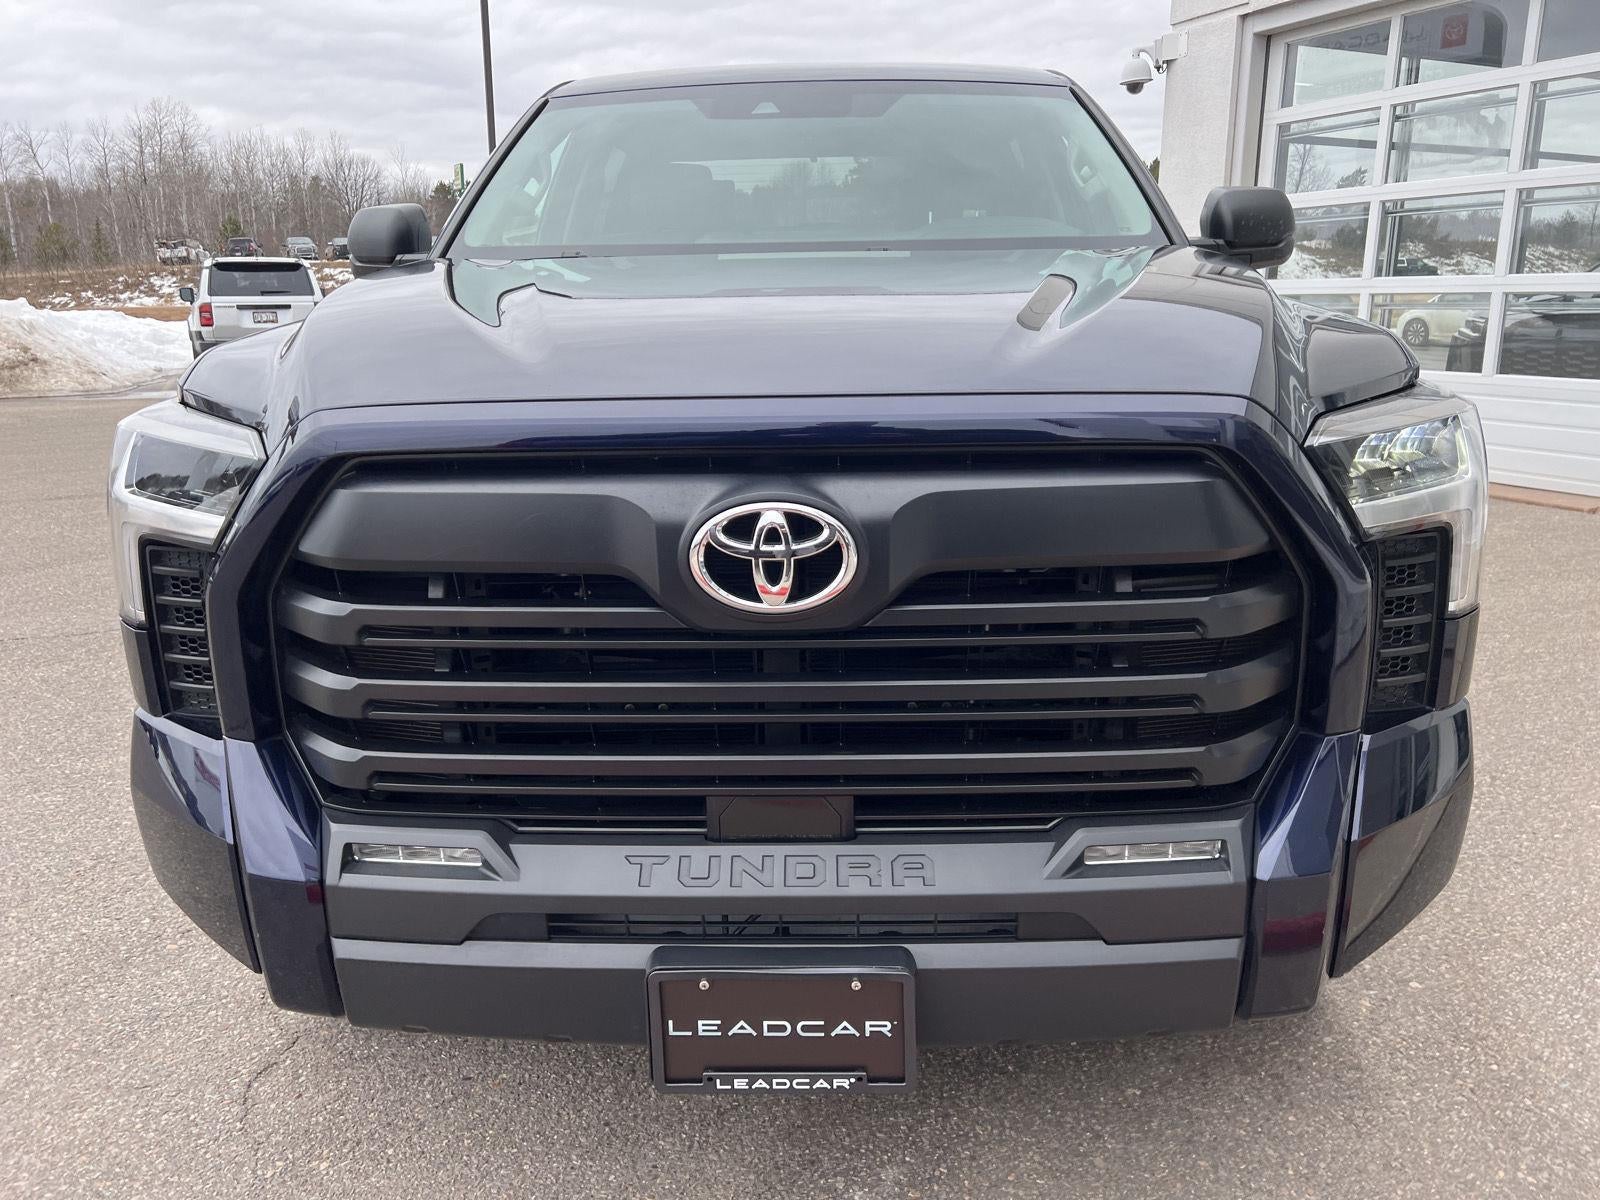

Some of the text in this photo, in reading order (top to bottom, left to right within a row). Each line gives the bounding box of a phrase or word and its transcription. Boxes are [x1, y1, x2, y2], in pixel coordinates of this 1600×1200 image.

[624, 854, 936, 887] TUNDRA
[668, 1019, 893, 1037] LEADCAR
[716, 1078, 851, 1090] LEADCAR
